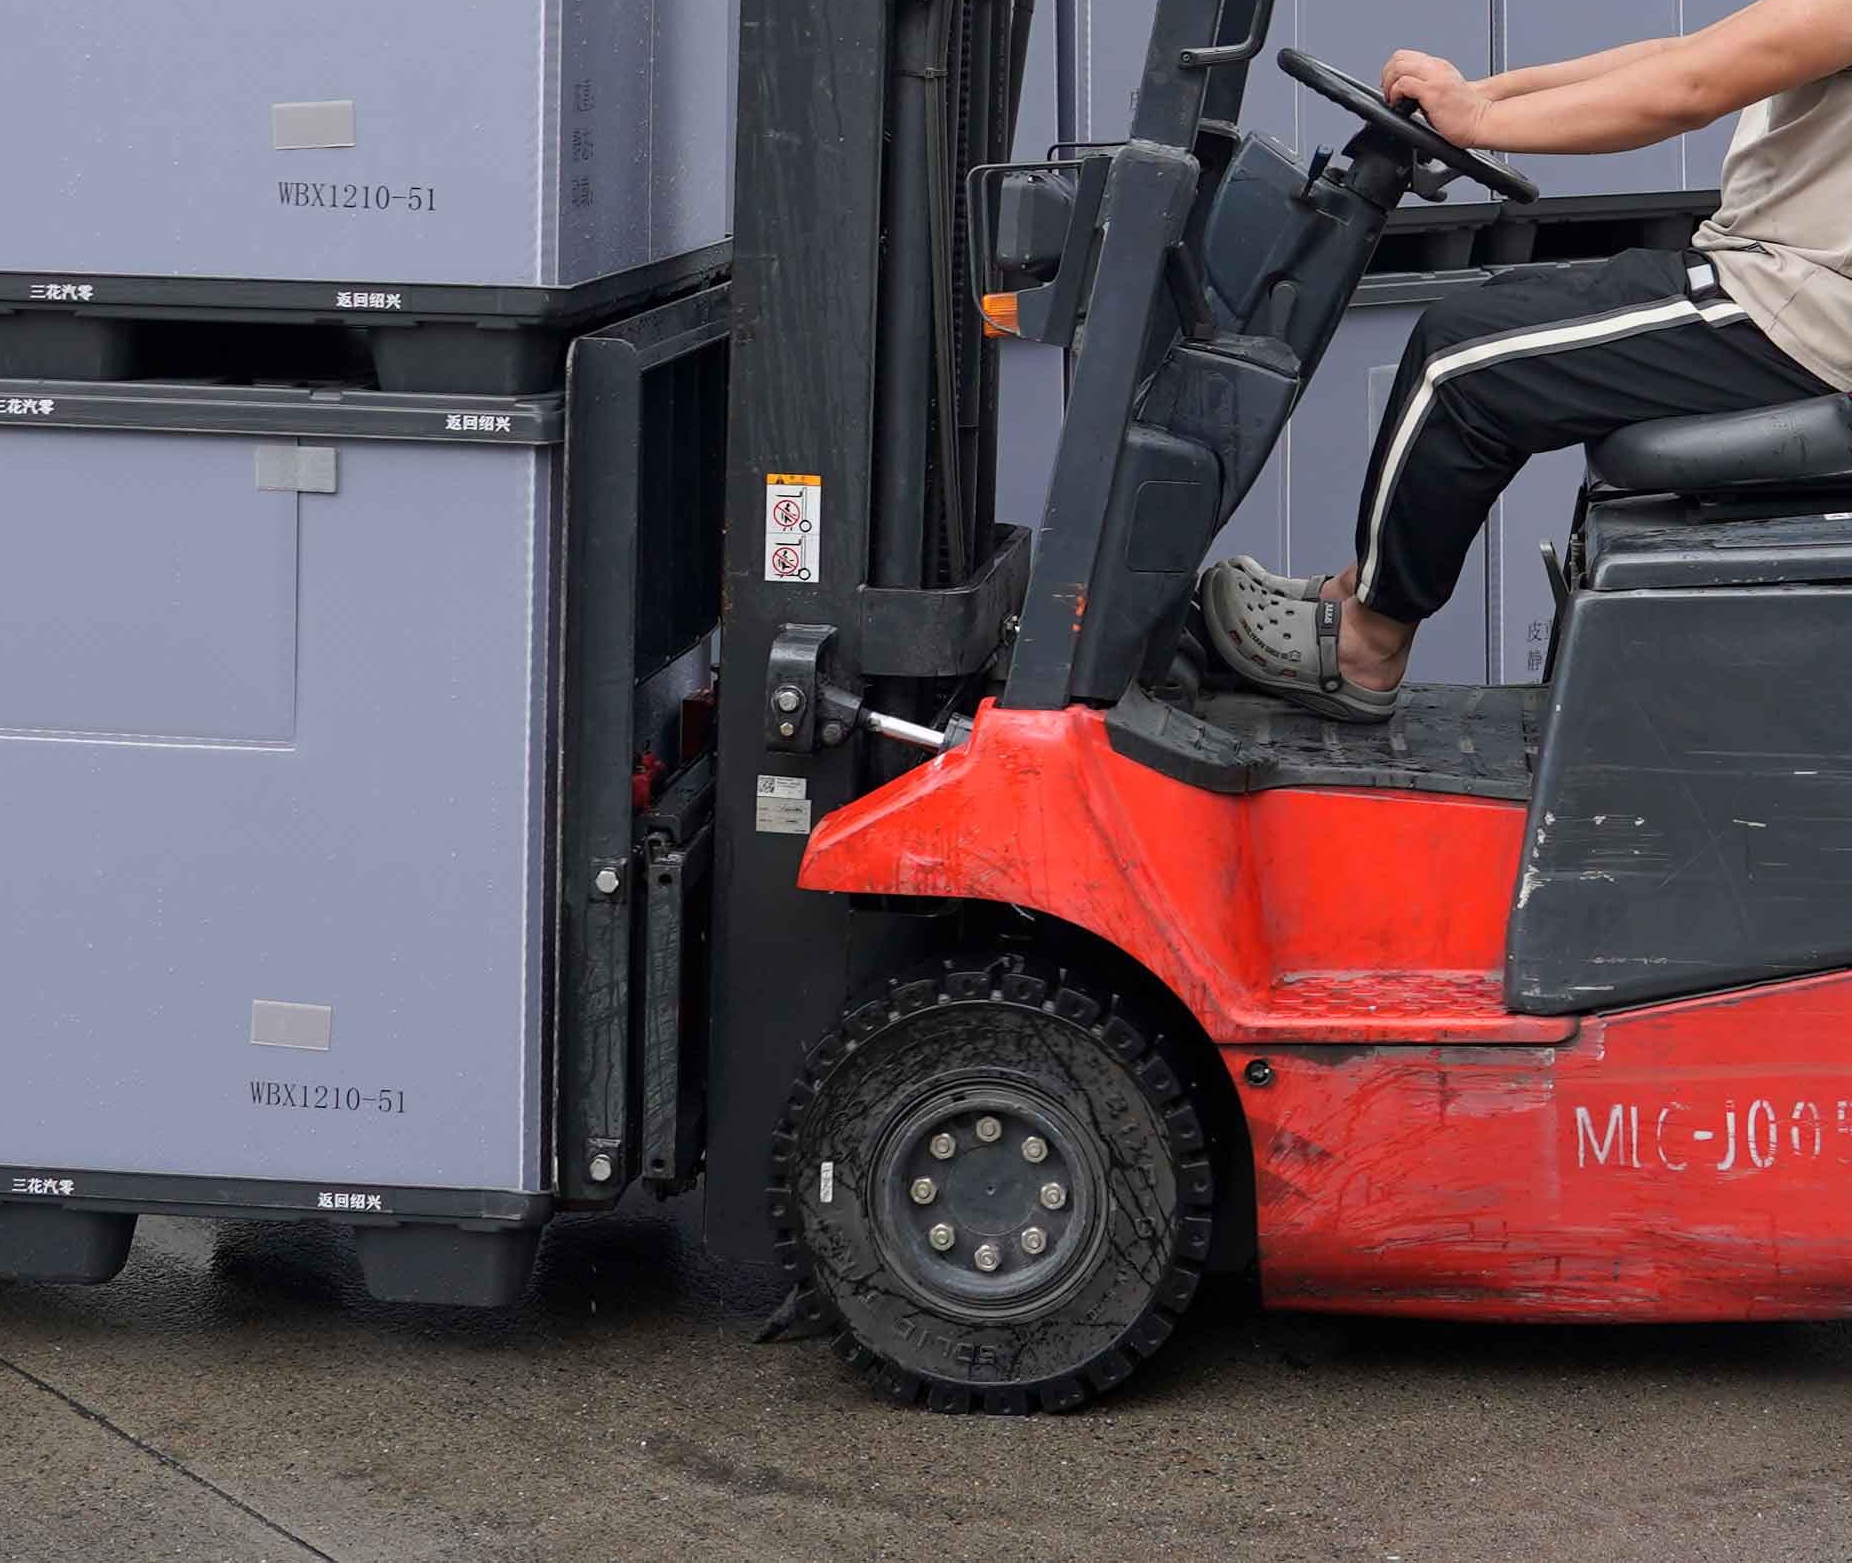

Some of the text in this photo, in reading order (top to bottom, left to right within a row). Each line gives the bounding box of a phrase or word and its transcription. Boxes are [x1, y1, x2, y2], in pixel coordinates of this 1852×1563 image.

[278, 180, 437, 212] WBX1210-51
[29, 283, 94, 301] 三花汽零
[335, 291, 402, 310] 返回绍兴
[445, 414, 512, 433] 返回绍兴
[249, 1080, 406, 1115] WBX1210-51
[11, 1177, 75, 1196] 三花汽零
[317, 1192, 383, 1211] 返回绍兴
